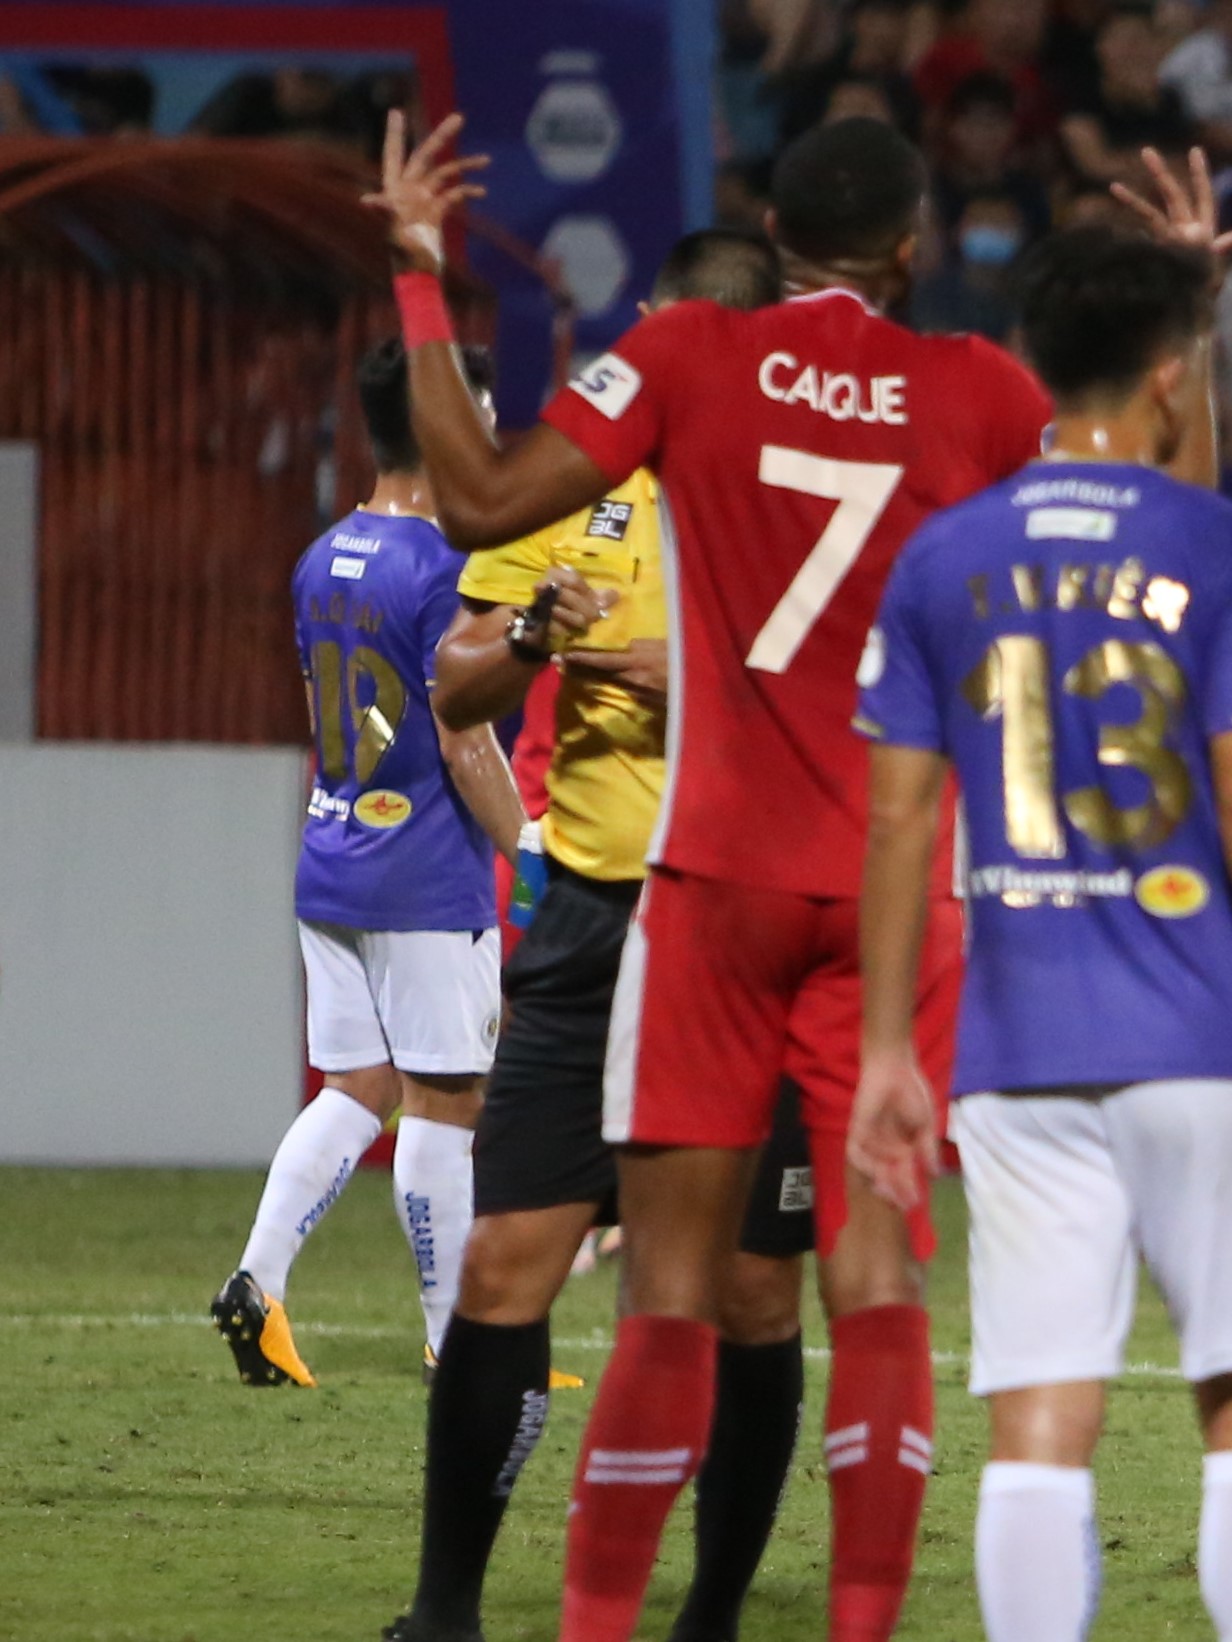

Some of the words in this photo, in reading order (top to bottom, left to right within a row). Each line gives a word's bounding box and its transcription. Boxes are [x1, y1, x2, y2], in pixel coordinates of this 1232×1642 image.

[758, 351, 907, 425] CAIQUE
[744, 444, 904, 674] 7
[961, 634, 1195, 859] 13
